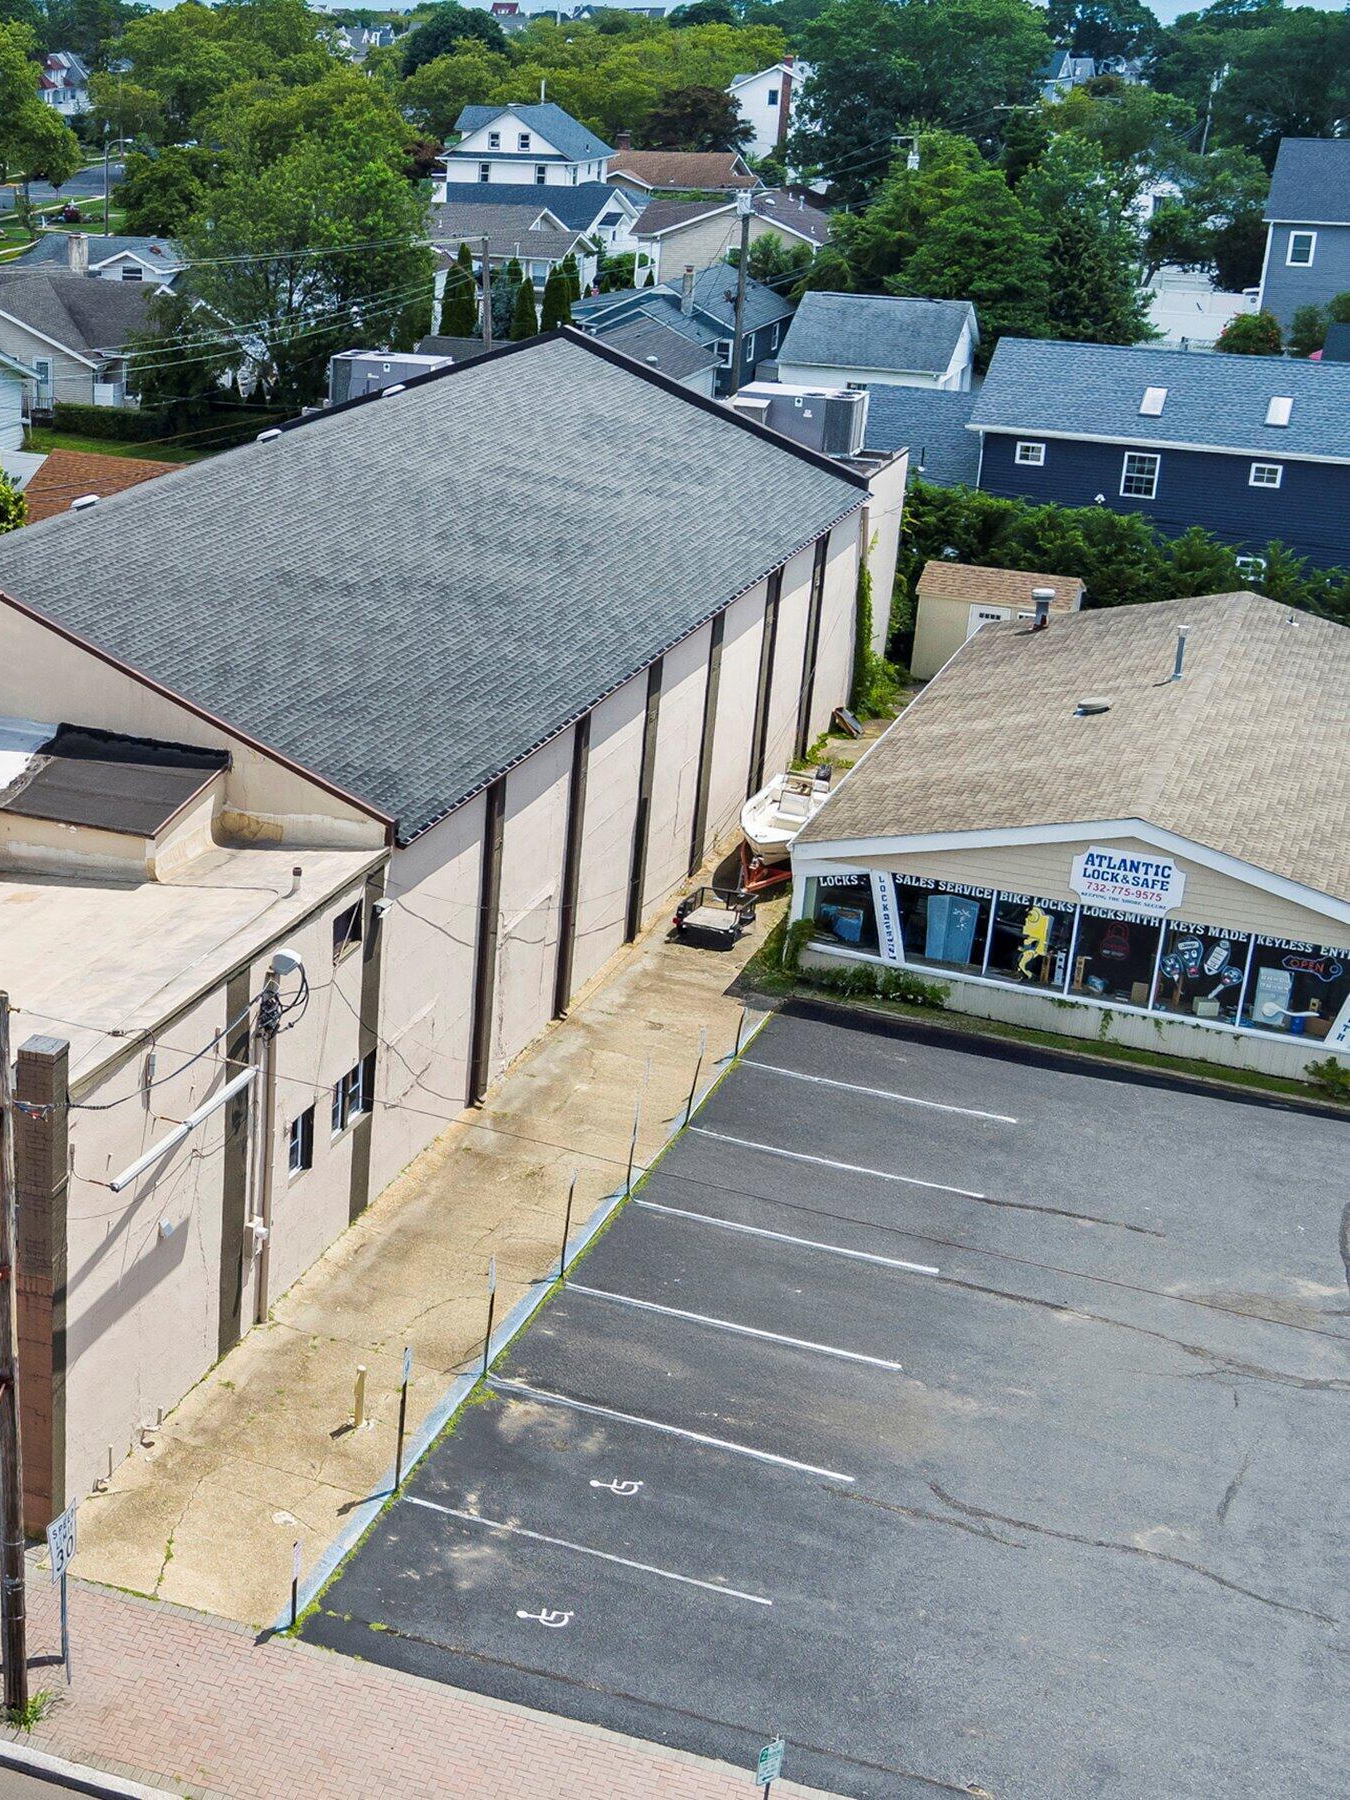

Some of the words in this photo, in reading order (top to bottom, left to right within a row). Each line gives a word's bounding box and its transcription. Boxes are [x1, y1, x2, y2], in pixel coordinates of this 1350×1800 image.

[1084, 853, 1172, 879] ATLANTIC
[819, 875, 858, 887] LOCKS
[895, 873, 935, 889] SALES
[938, 881, 992, 899] SERVICE
[1086, 881, 1162, 902] 732-775-9575
[1000, 892, 1030, 905] BIKE
[1033, 897, 1075, 913] LOCKS
[1082, 905, 1160, 927] LOCKSMITH
[1169, 921, 1206, 935] KEYS
[1208, 926, 1248, 942] MADE
[1256, 935, 1313, 953] KEYLESS
[1289, 959, 1325, 973] OPEN
